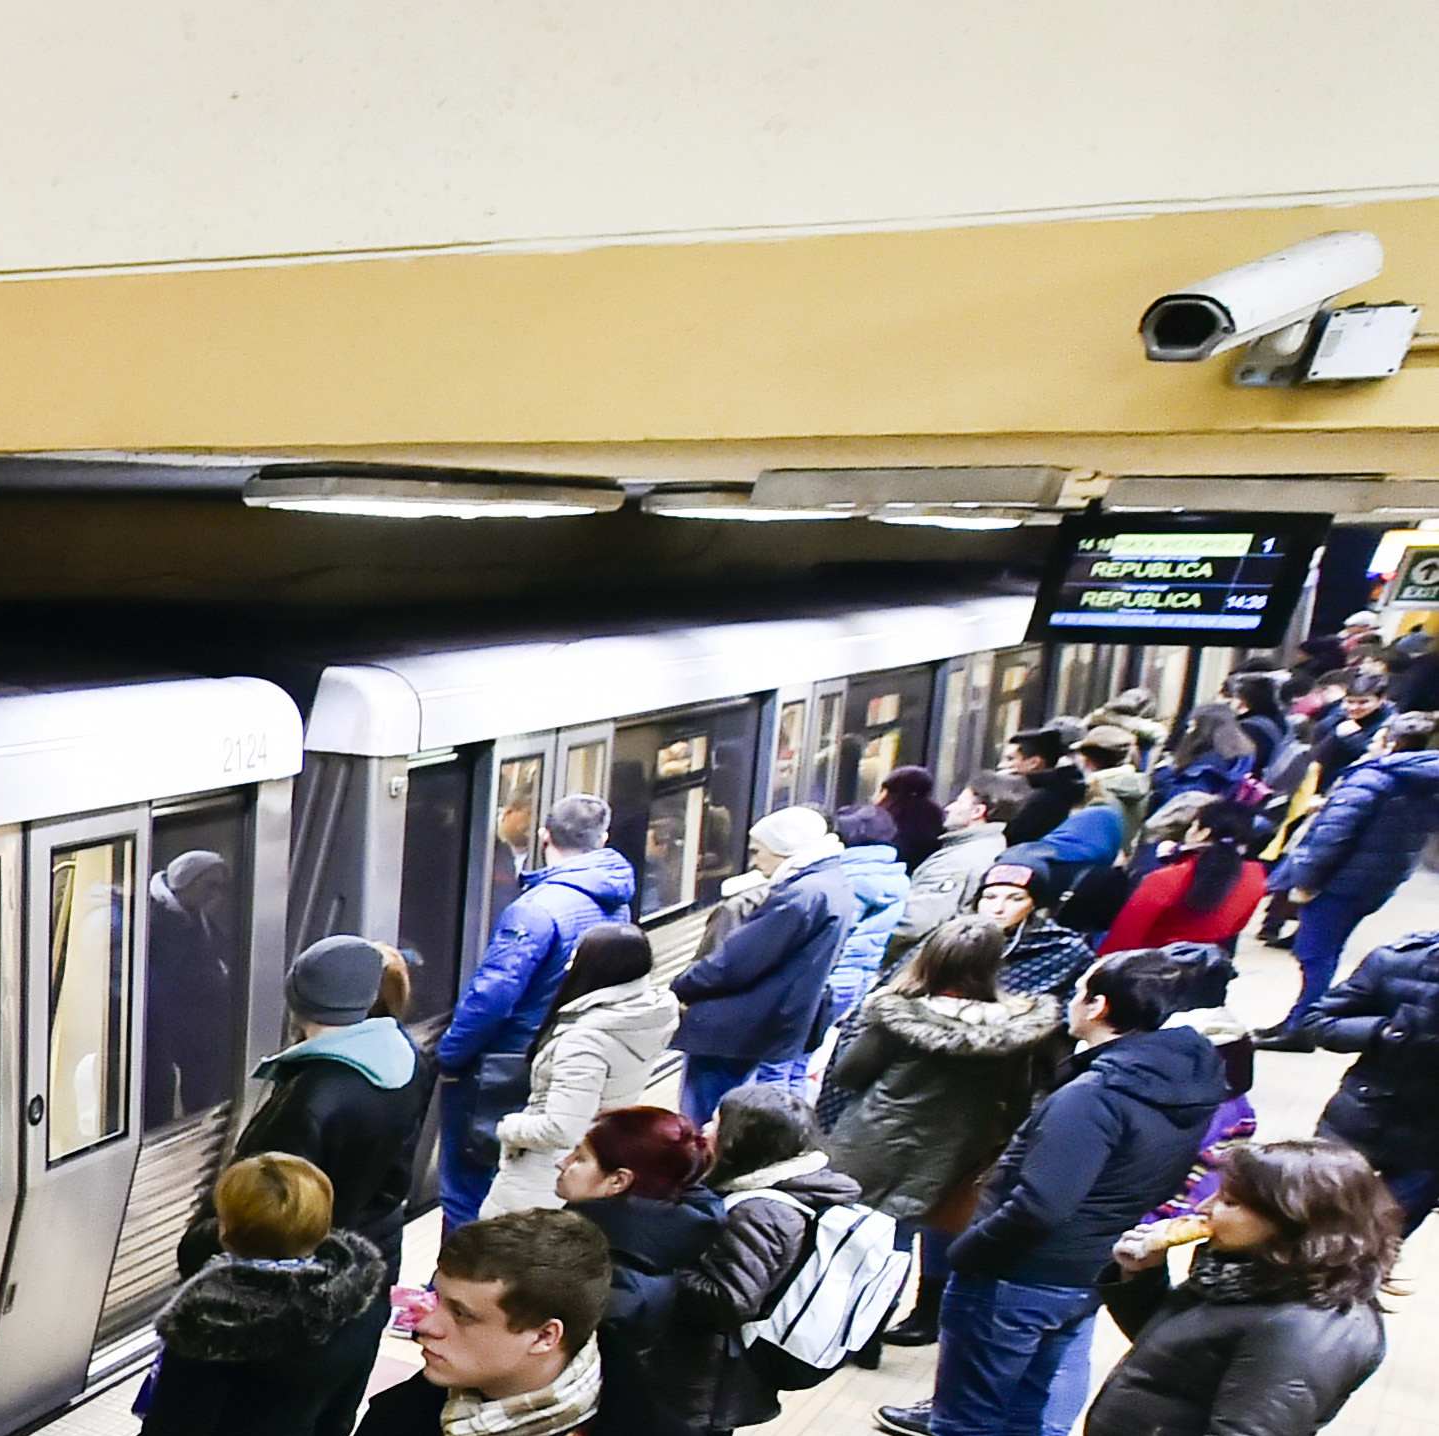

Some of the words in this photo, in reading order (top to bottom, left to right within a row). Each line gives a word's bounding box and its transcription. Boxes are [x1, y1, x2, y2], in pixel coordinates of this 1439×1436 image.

[1089, 562, 1213, 578] REPUBLICA
[1079, 591, 1202, 608] REPUBLICA
[224, 734, 267, 773] 2124
